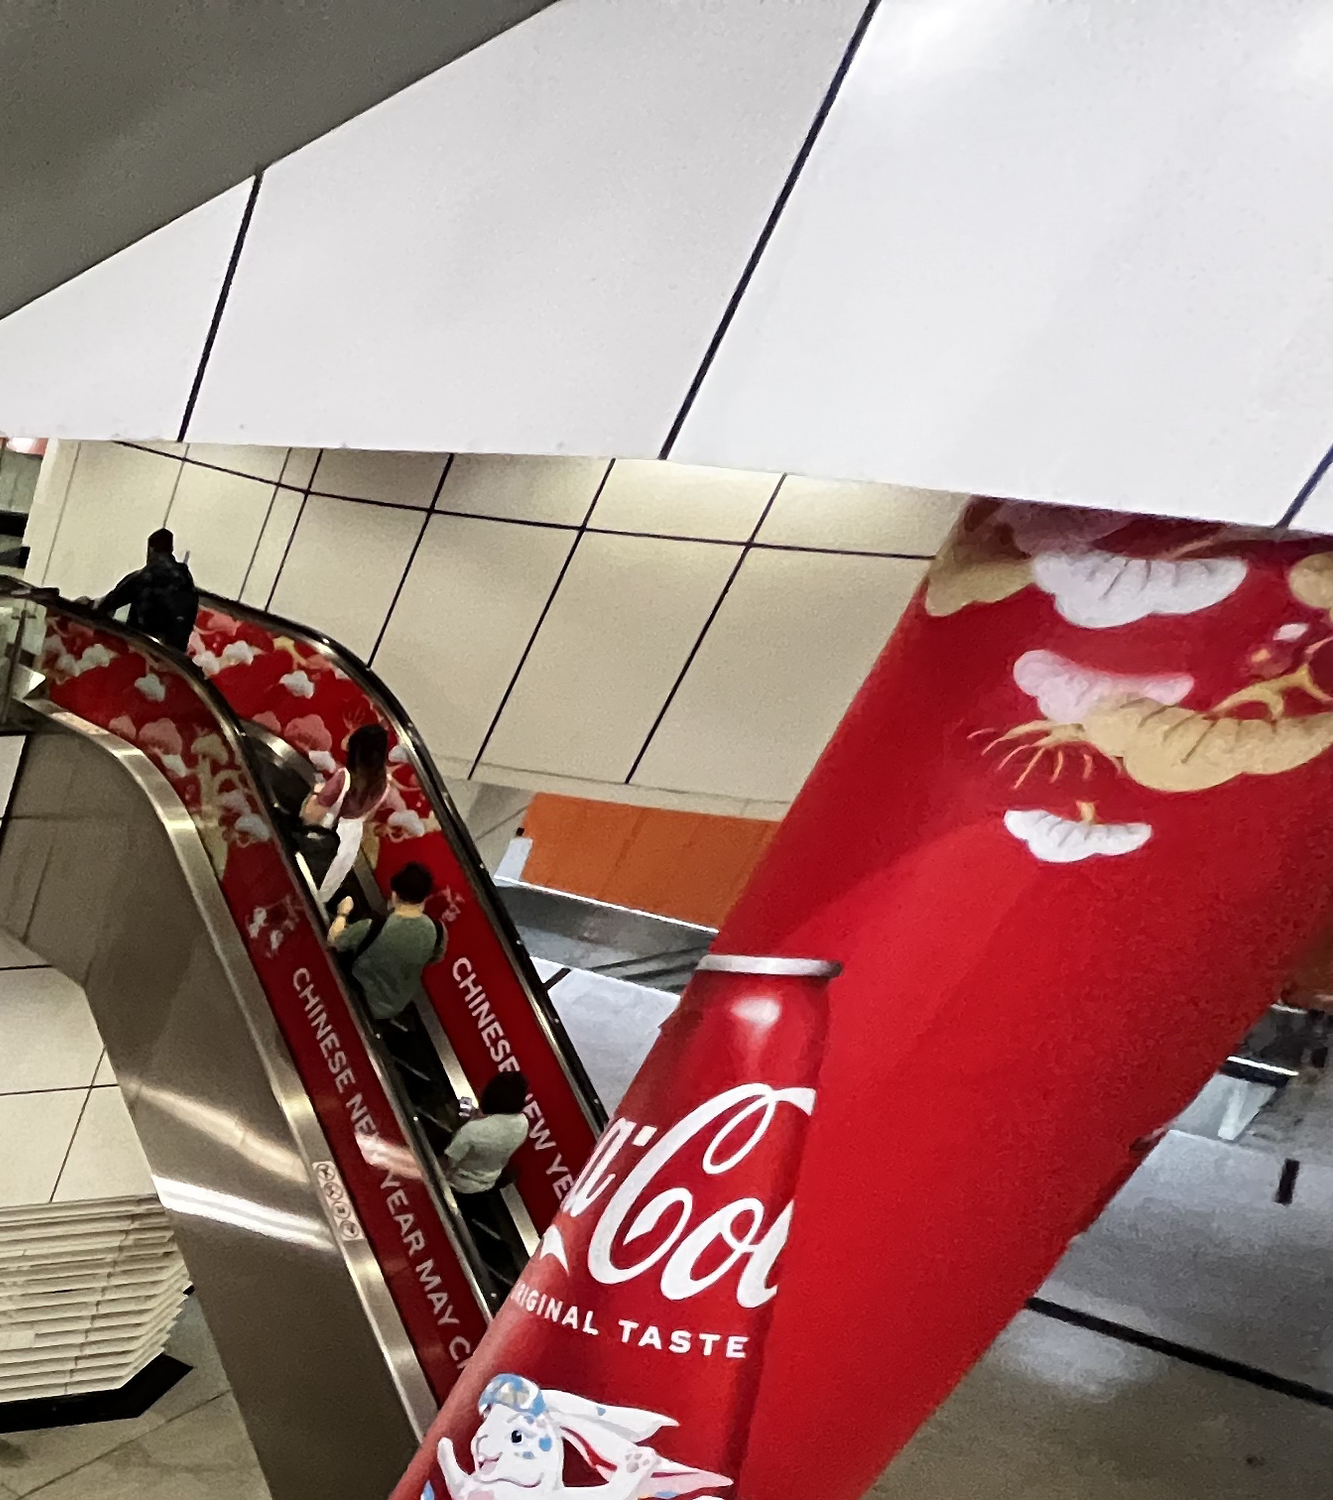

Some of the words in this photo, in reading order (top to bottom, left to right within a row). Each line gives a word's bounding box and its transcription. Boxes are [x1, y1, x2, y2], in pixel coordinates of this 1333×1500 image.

[292, 967, 357, 1094] CHINESE
[379, 1170, 426, 1257] YEAR
[416, 1258, 461, 1326] MAY
[618, 1319, 749, 1359] TASTE
